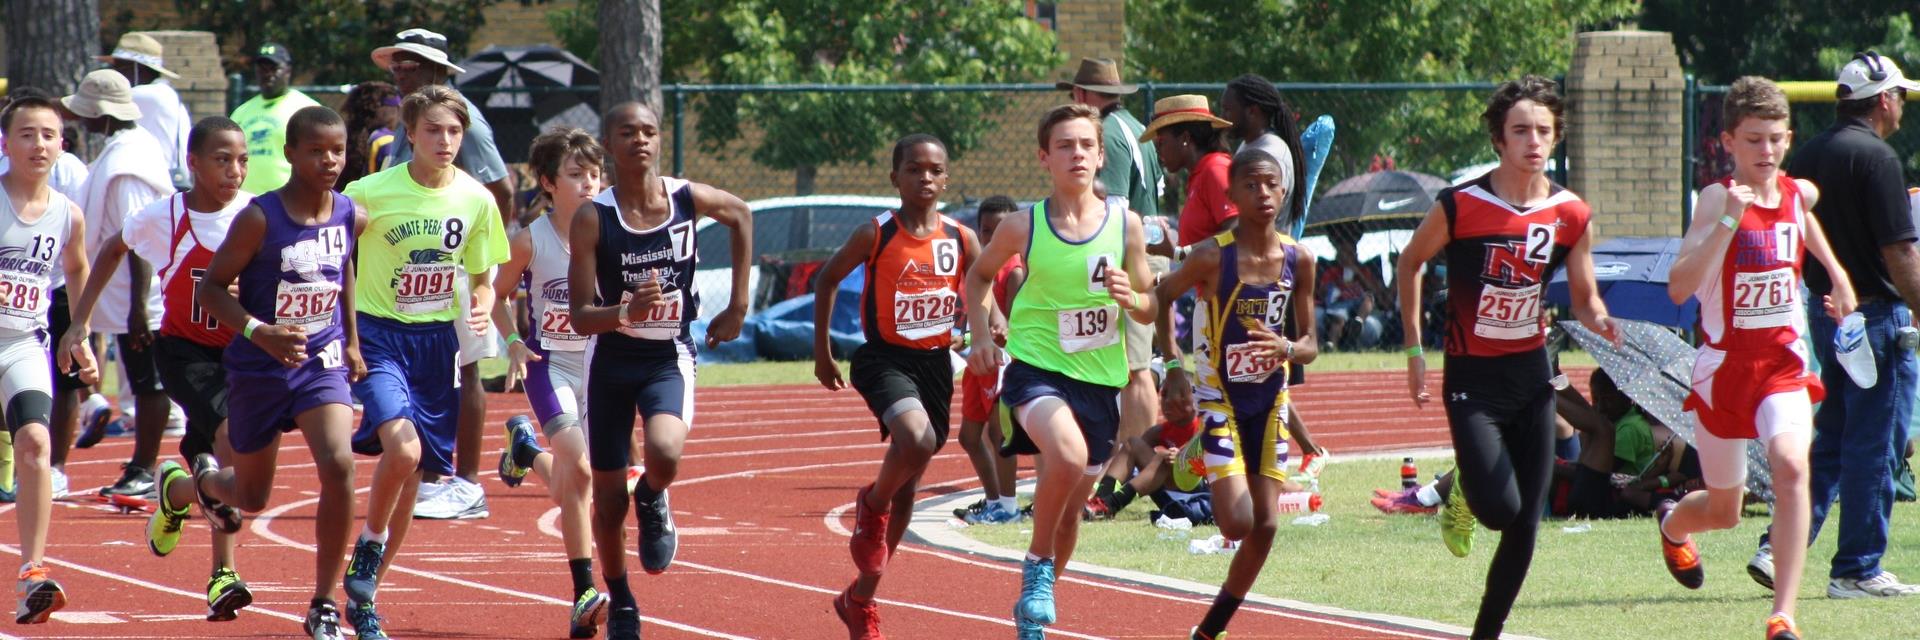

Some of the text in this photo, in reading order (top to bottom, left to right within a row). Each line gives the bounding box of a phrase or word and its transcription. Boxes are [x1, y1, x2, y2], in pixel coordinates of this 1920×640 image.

[31, 234, 56, 261] 13
[320, 228, 343, 254] 14
[384, 220, 420, 247] ULTIMATE
[444, 217, 464, 250] 8
[672, 225, 690, 258] 7
[1529, 227, 1550, 261] 2
[1781, 226, 1792, 258] 1
[621, 246, 673, 266] Mississip
[936, 242, 955, 273] 6
[397, 271, 455, 297] 3091
[1092, 256, 1108, 287] 4
[276, 289, 338, 318] 2362
[541, 288, 569, 300] HURR
[1236, 299, 1269, 315] MT
[1480, 294, 1539, 321] 2577
[1735, 279, 1793, 308] 2761
[896, 295, 956, 324] 2628
[1269, 294, 1287, 325] 3
